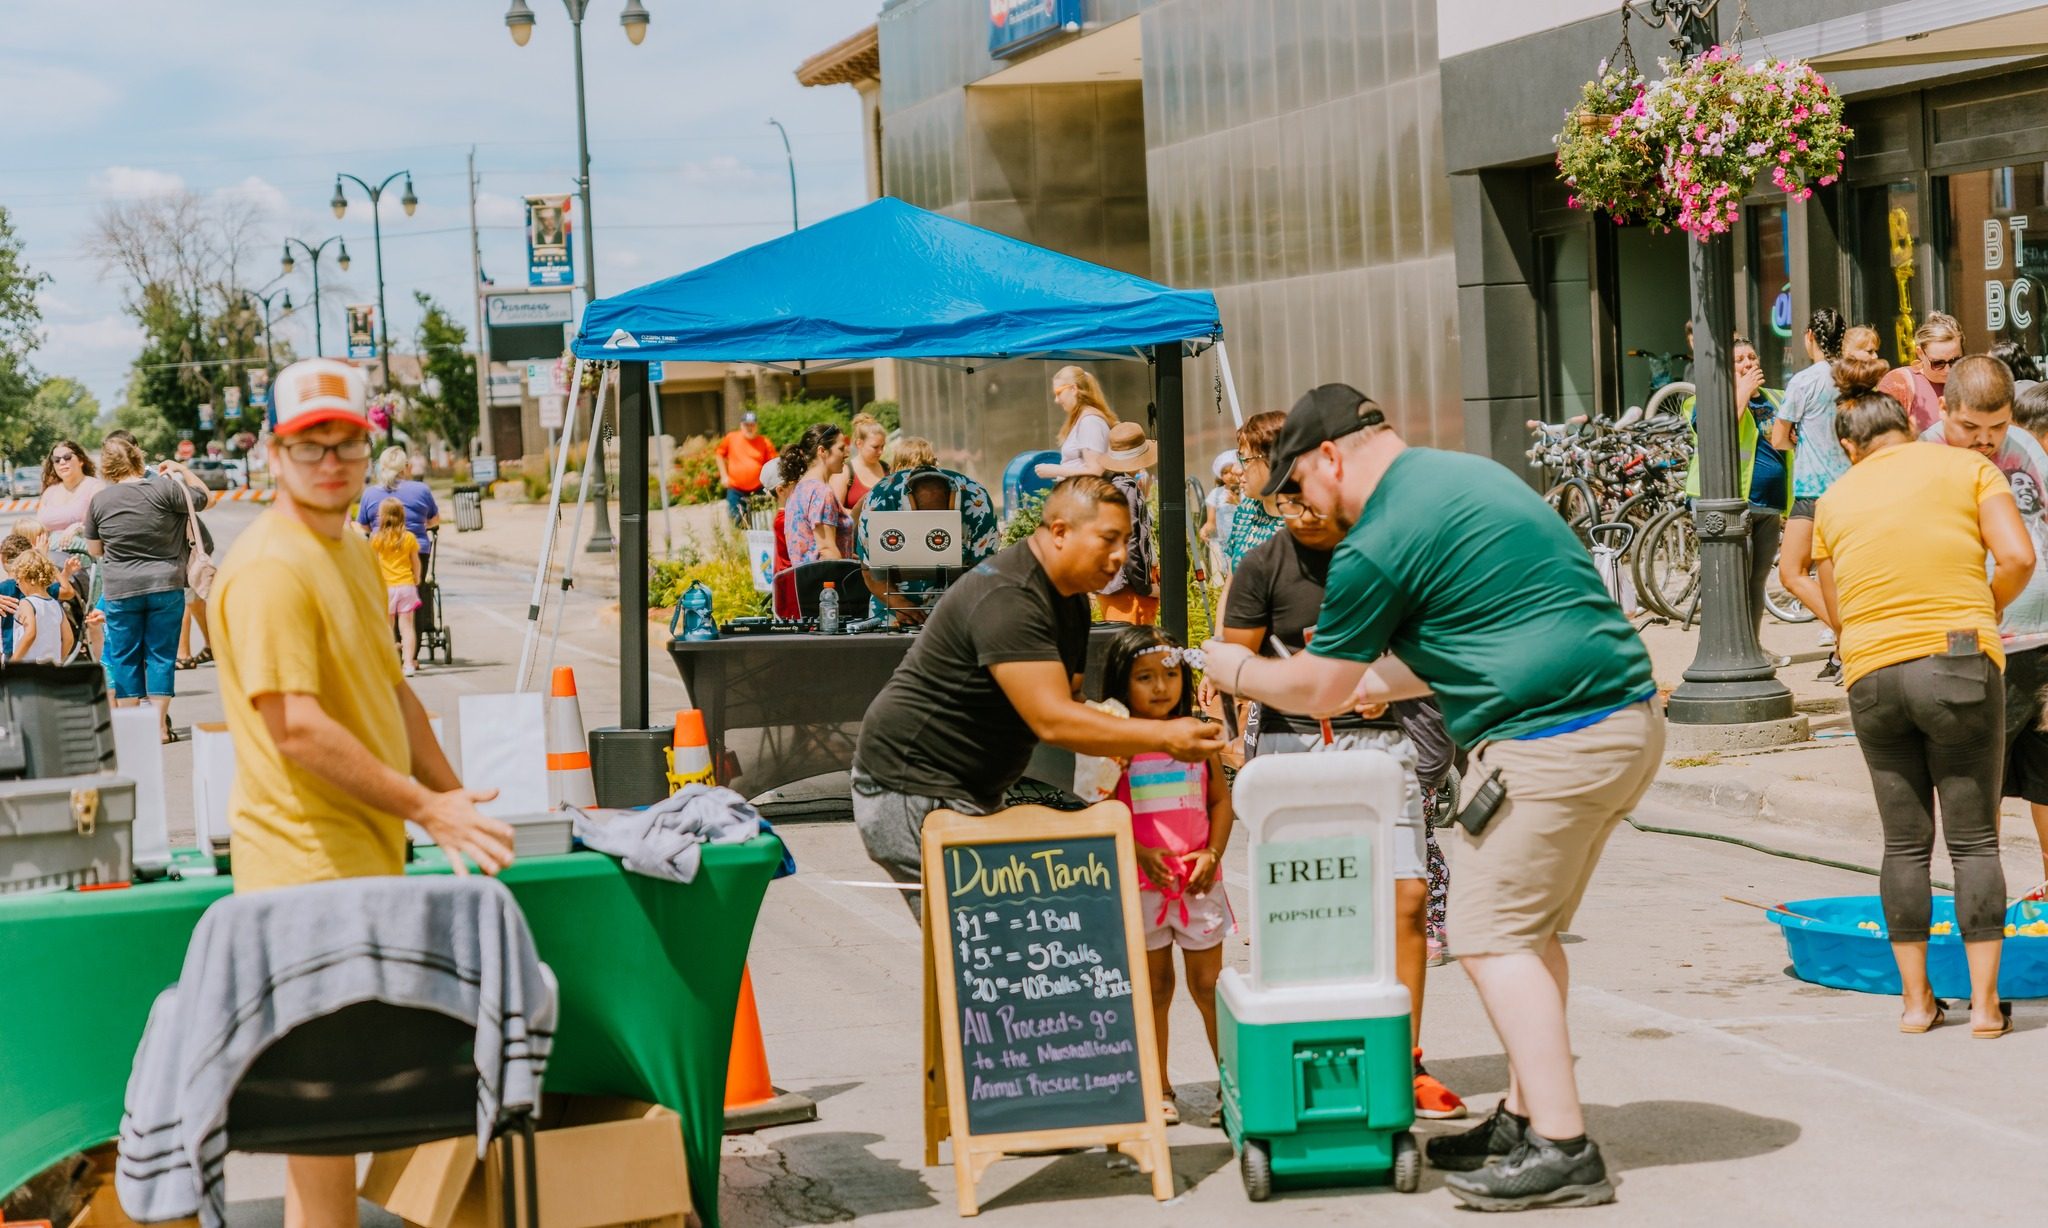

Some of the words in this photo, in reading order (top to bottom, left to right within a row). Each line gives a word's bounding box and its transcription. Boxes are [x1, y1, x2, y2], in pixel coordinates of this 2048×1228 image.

[1984, 215, 2028, 270] BT
[1985, 277, 2033, 332] BC
[827, 609, 836, 620] G
[944, 846, 1041, 897] Dunk
[1031, 848, 1112, 892] Tank
[1268, 856, 1358, 885] FREE
[1042, 908, 1082, 933] Ball
[1268, 905, 1357, 924] POPSICLES
[963, 1006, 994, 1046] All
[995, 1004, 1084, 1044] Proceeds
[1089, 1009, 1118, 1040] go
[971, 1050, 995, 1070] to
[1000, 1050, 1031, 1070] the
[971, 1074, 1024, 1101] Animal
[1025, 1072, 1083, 1097] Rescue
[1084, 1069, 1138, 1095] League
